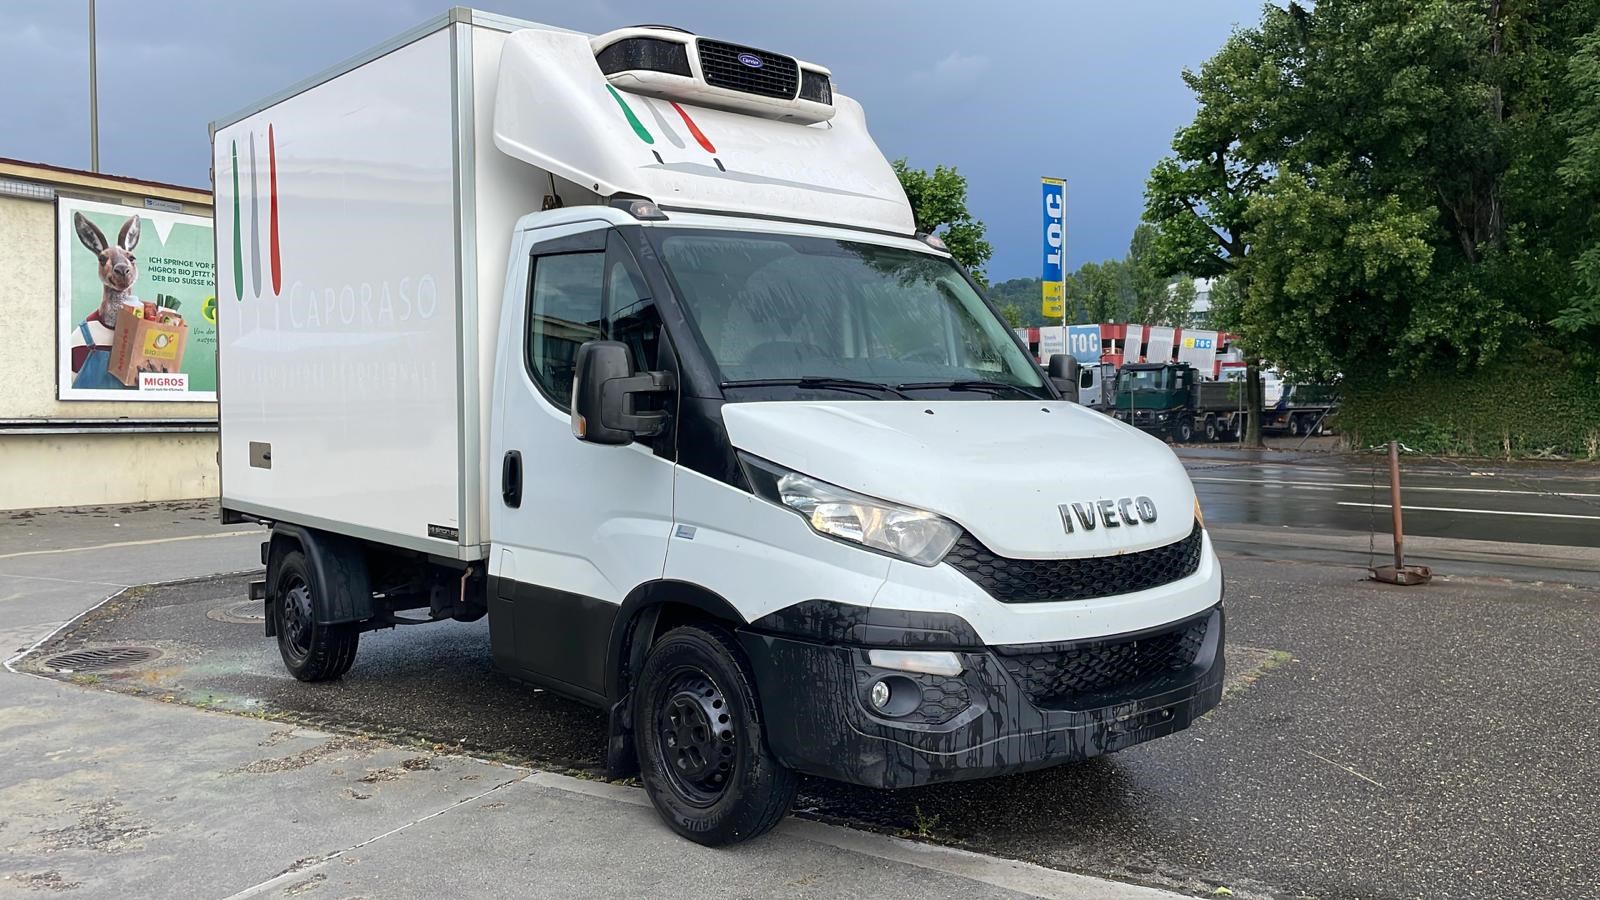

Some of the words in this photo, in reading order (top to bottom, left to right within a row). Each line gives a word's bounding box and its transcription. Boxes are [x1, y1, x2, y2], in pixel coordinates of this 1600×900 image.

[163, 258, 194, 268] SPRINGE
[148, 266, 177, 274] MIGROS
[181, 278, 205, 286] SUISSE
[289, 274, 437, 329] CAPORASO
[144, 377, 184, 387] MIGROS
[1058, 496, 1158, 534] IVECO
